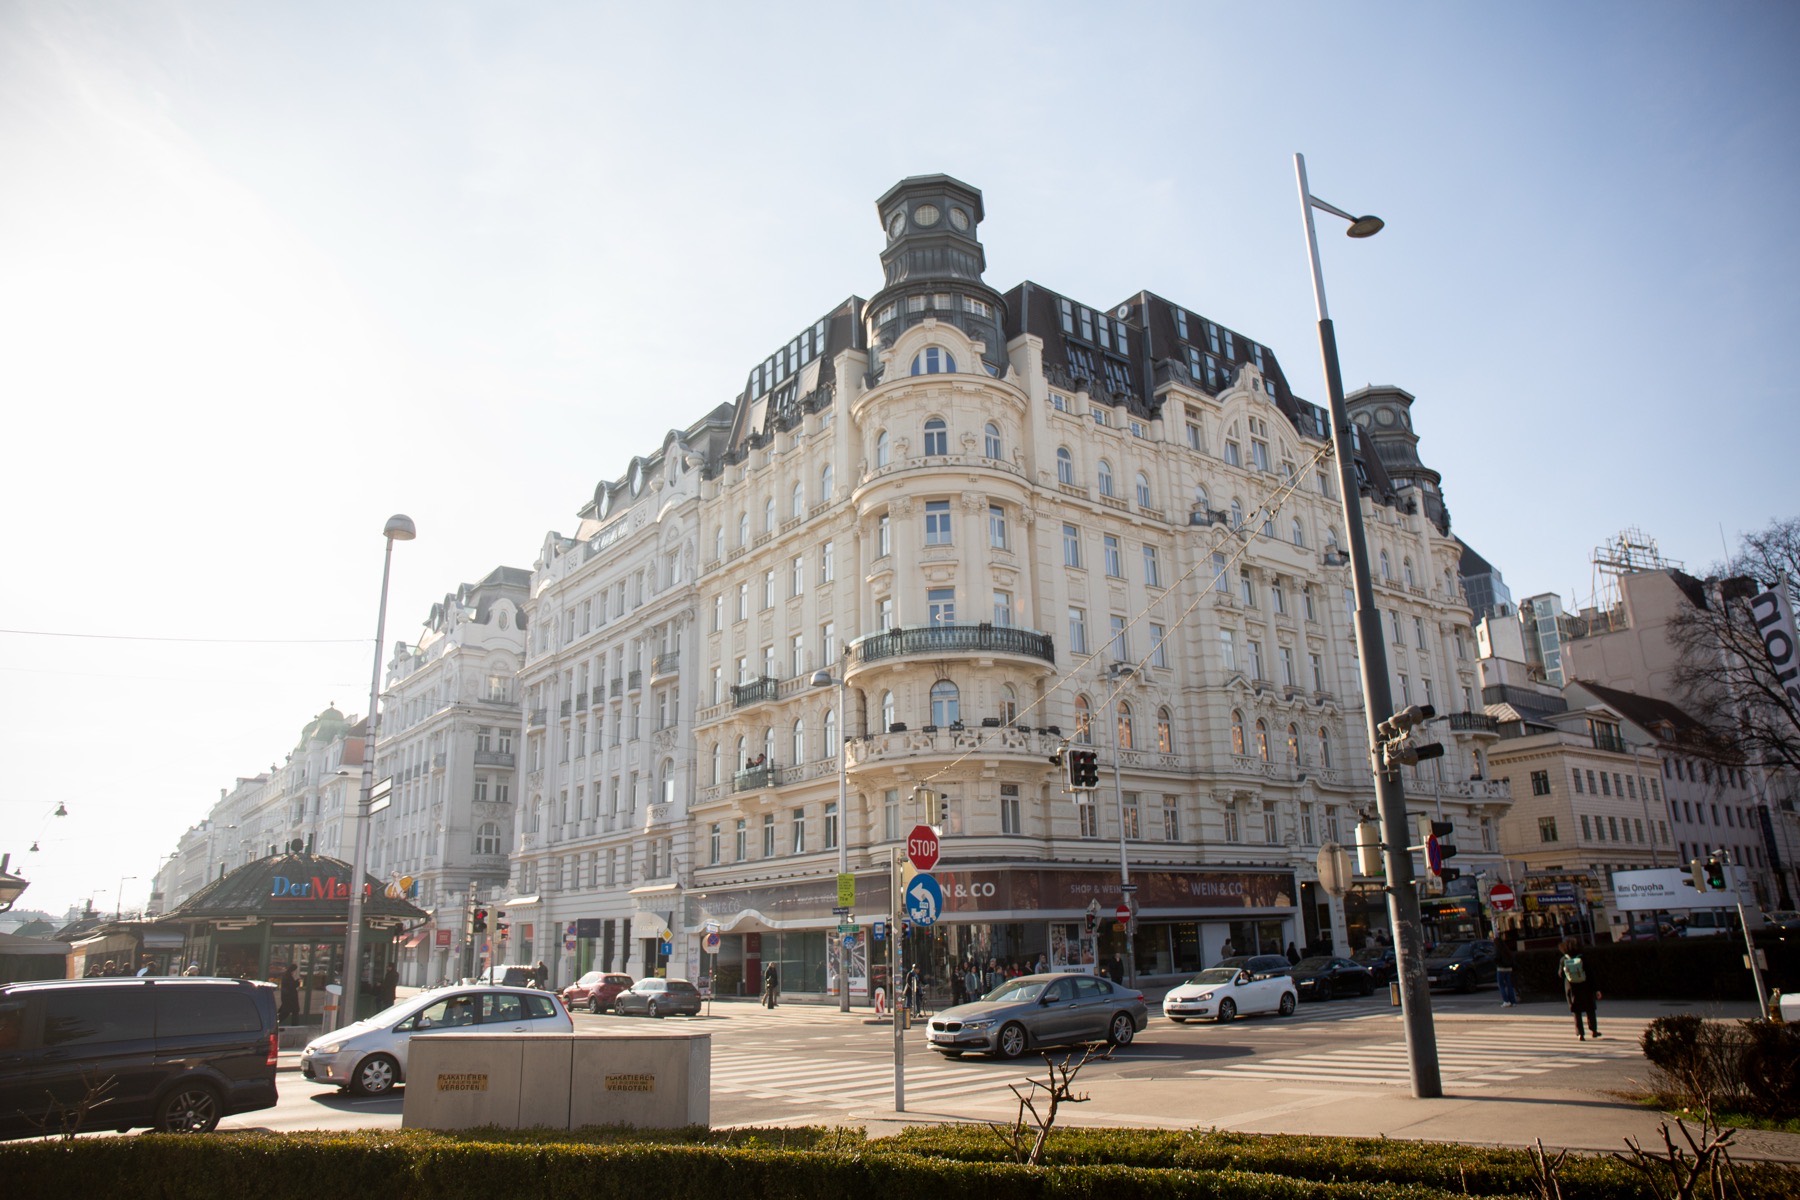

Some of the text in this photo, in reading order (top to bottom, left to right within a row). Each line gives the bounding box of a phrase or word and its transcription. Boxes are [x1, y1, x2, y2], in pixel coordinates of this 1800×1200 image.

[910, 839, 936, 856] STOP
[954, 884, 967, 897] &
[970, 882, 996, 897] CO
[1071, 885, 1091, 893] SHOP
[1094, 885, 1099, 893] &
